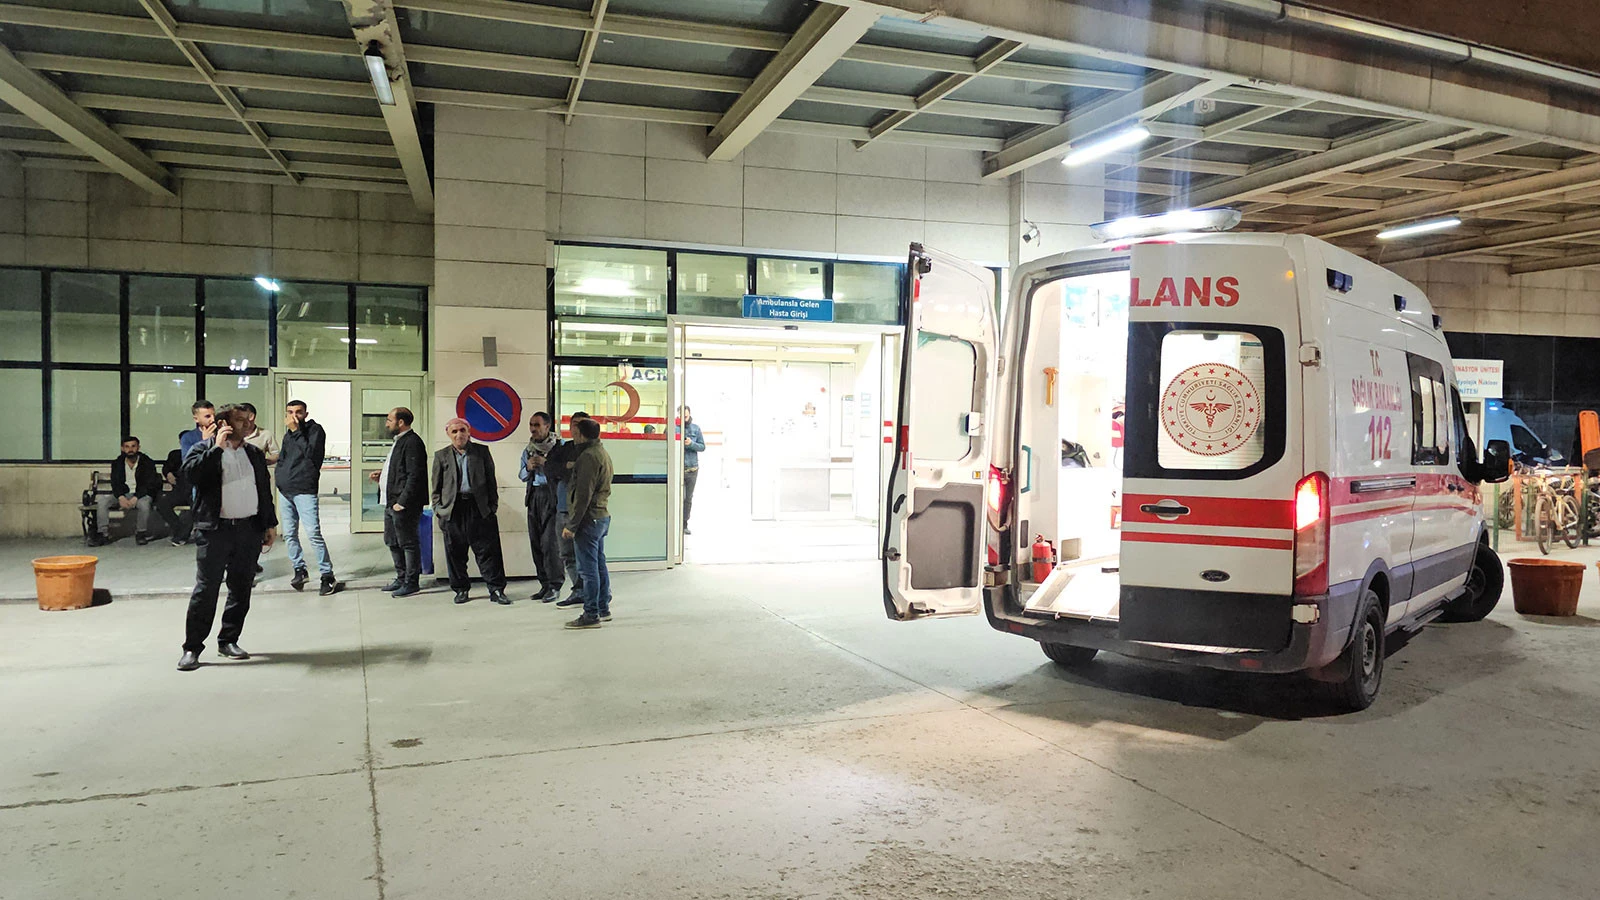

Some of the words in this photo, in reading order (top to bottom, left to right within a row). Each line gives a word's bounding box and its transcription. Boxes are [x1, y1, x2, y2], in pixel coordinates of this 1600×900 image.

[1130, 276, 1240, 307] LANS
[757, 298, 798, 307] Ambulansla
[799, 301, 820, 309] Gelen
[769, 309, 789, 317] Hasta
[790, 310, 809, 320] Girişi
[1368, 415, 1392, 461] 112
